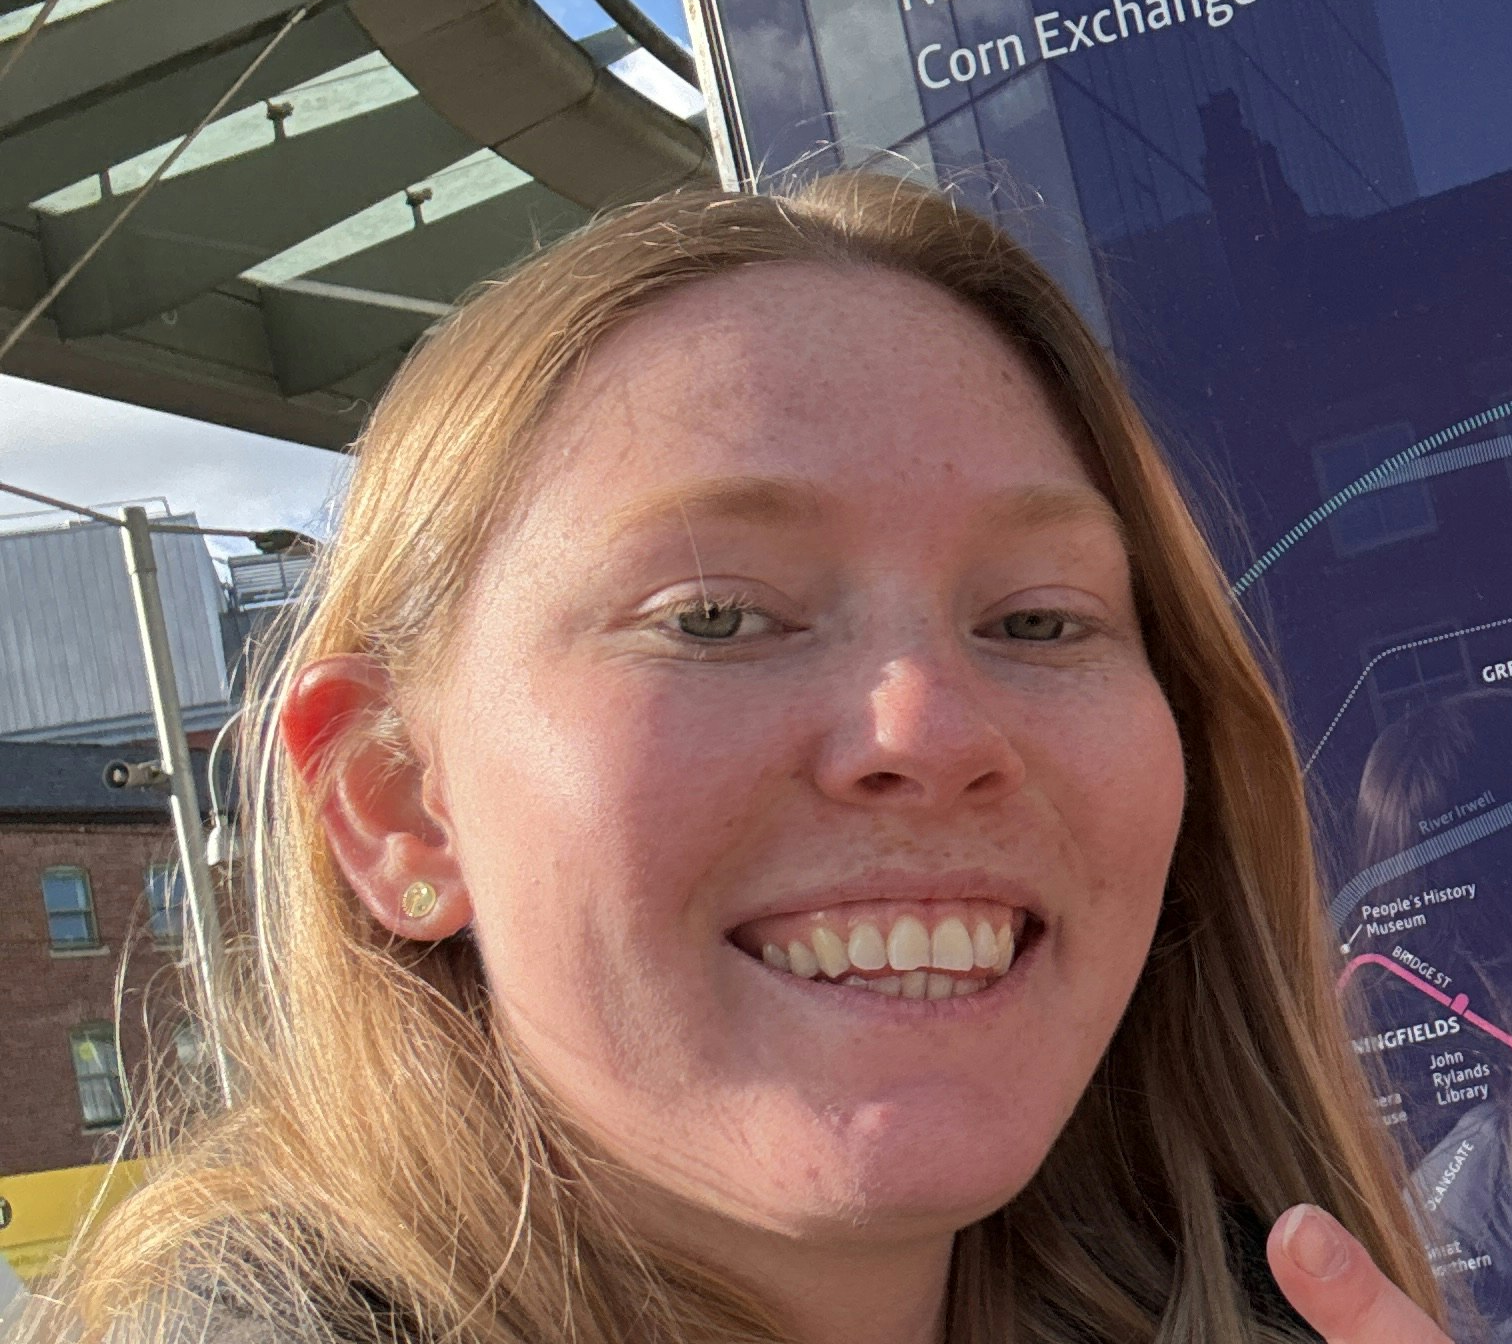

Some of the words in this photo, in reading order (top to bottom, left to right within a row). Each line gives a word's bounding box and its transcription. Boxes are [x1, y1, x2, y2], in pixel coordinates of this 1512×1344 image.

[918, 25, 1027, 93] Corn
[1418, 811, 1455, 835] River
[1455, 790, 1496, 818] Irwell
[1361, 896, 1422, 920] People's
[1424, 884, 1476, 905] History
[1366, 914, 1427, 938] Museum
[1392, 946, 1437, 983] BRIDGE
[1436, 972, 1453, 989] ST
[1430, 1051, 1463, 1070] John
[1432, 1063, 1490, 1089] Rylands
[1436, 1084, 1489, 1106] Library
